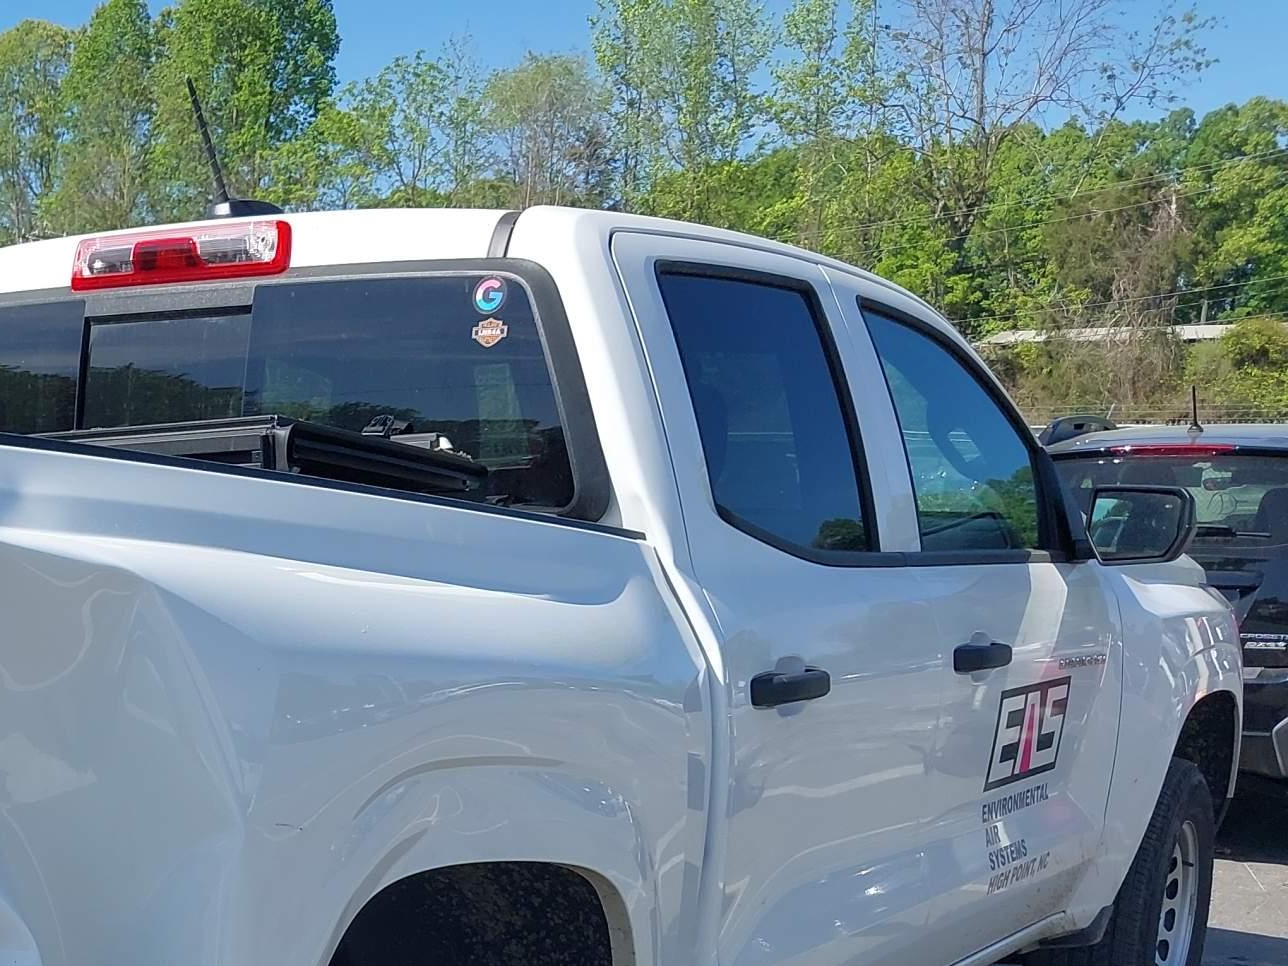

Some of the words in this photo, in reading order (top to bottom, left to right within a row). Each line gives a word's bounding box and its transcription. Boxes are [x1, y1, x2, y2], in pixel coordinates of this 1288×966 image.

[981, 783, 1049, 823] ENVIRONMENTAL
[985, 824, 1002, 848] AIR
[988, 839, 1028, 871] SYSTEMS
[986, 869, 1011, 896] HIGH
[1010, 857, 1037, 885] POINT,
[1036, 851, 1050, 873] NC
